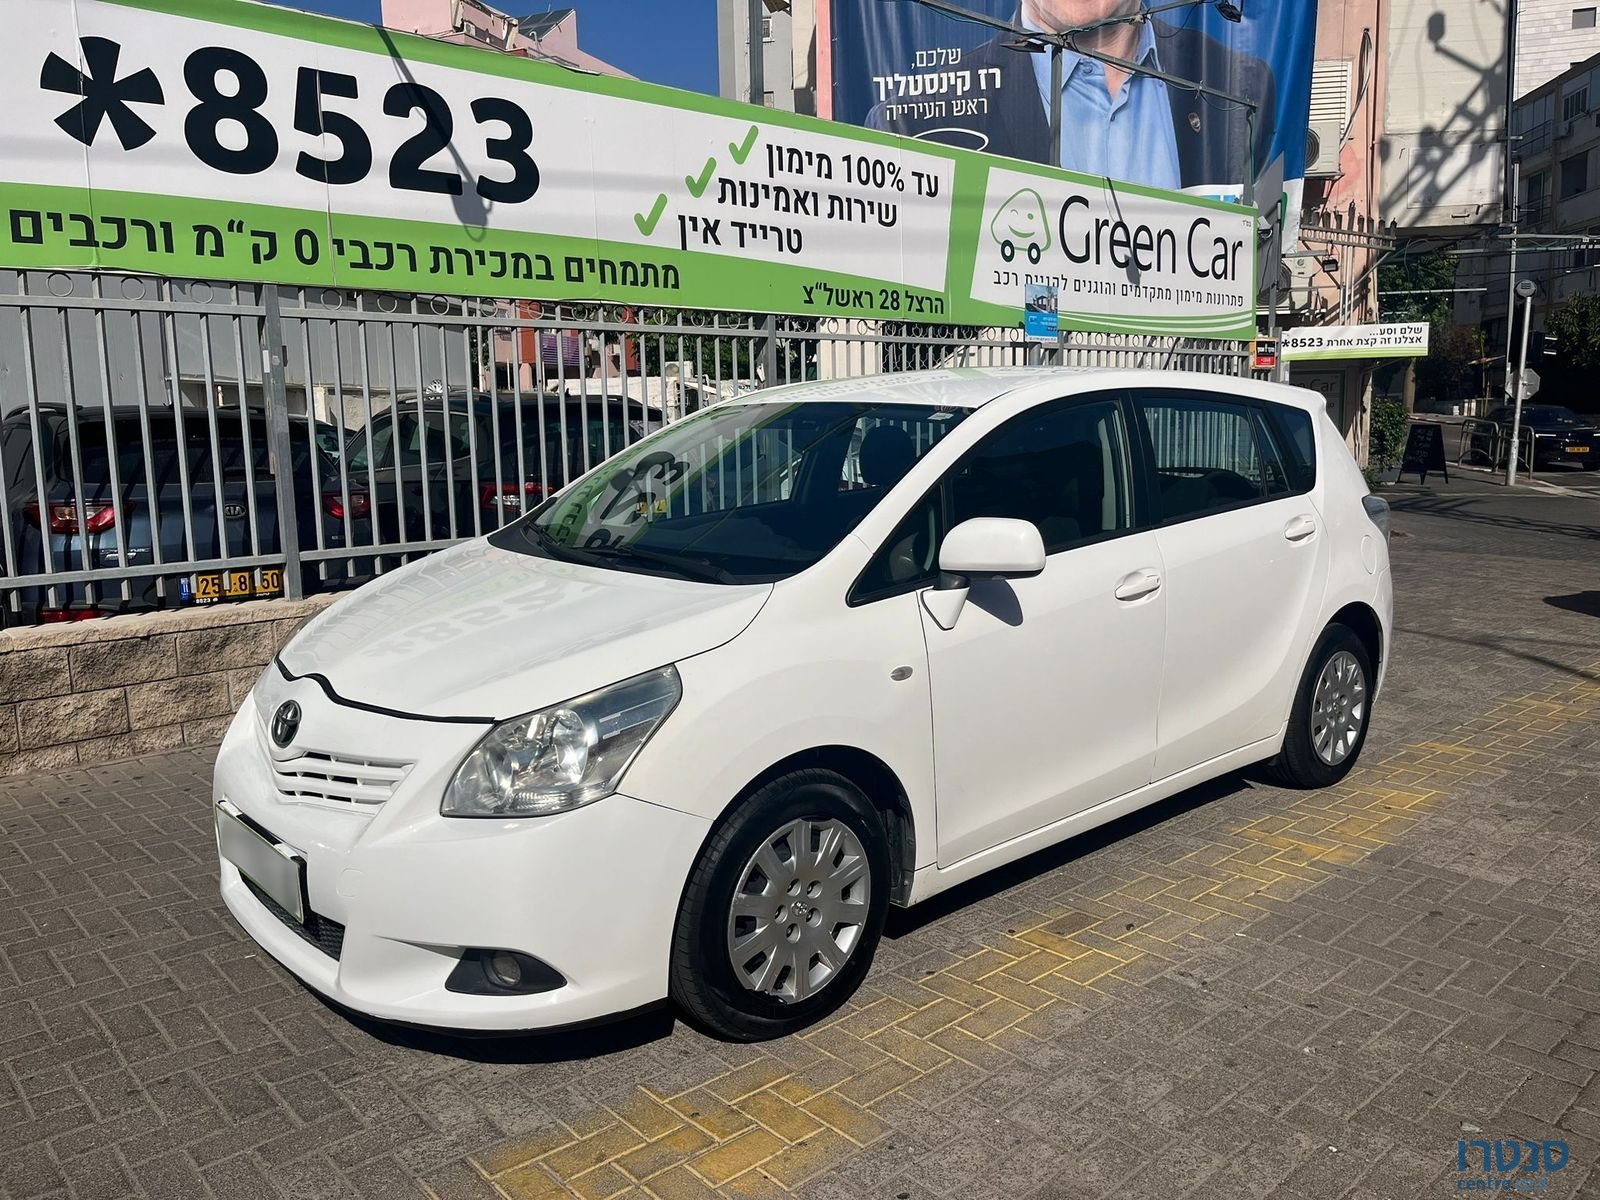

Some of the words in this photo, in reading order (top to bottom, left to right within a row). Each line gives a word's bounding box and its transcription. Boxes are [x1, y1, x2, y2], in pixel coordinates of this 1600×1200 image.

[911, 47, 961, 69] שלכם,
[873, 70, 970, 102] קינסטליך
[978, 68, 1001, 90] רז
[886, 101, 946, 121] העירייה
[951, 97, 988, 117] ראש
[765, 143, 833, 179] מימון
[842, 155, 905, 192] 100%
[911, 171, 939, 198] עד
[717, 176, 819, 217] ואמינות
[827, 194, 897, 227] שירות
[9, 209, 175, 255] ורכבים
[677, 214, 721, 251] אין
[730, 221, 803, 254] טרייד
[1059, 195, 1177, 275] Green
[1187, 217, 1243, 281] Car
[294, 228, 320, 266] 0
[331, 238, 417, 272] רכבי
[429, 246, 555, 281] במכירת
[564, 255, 681, 290] מתמחים
[993, 270, 1019, 287] רכב
[1074, 279, 1116, 296] והוגנים
[879, 288, 901, 311] 28
[904, 289, 945, 315] הרצל
[1121, 284, 1172, 303] מתקדמים
[1176, 288, 1202, 305] מימון
[1206, 291, 1244, 307] פתרונות
[1326, 338, 1353, 347] אחרת
[1356, 337, 1377, 347] קצת
[1380, 336, 1391, 344] זה
[1395, 335, 1423, 345] אצלנו
[1400, 326, 1423, 335] שלם
